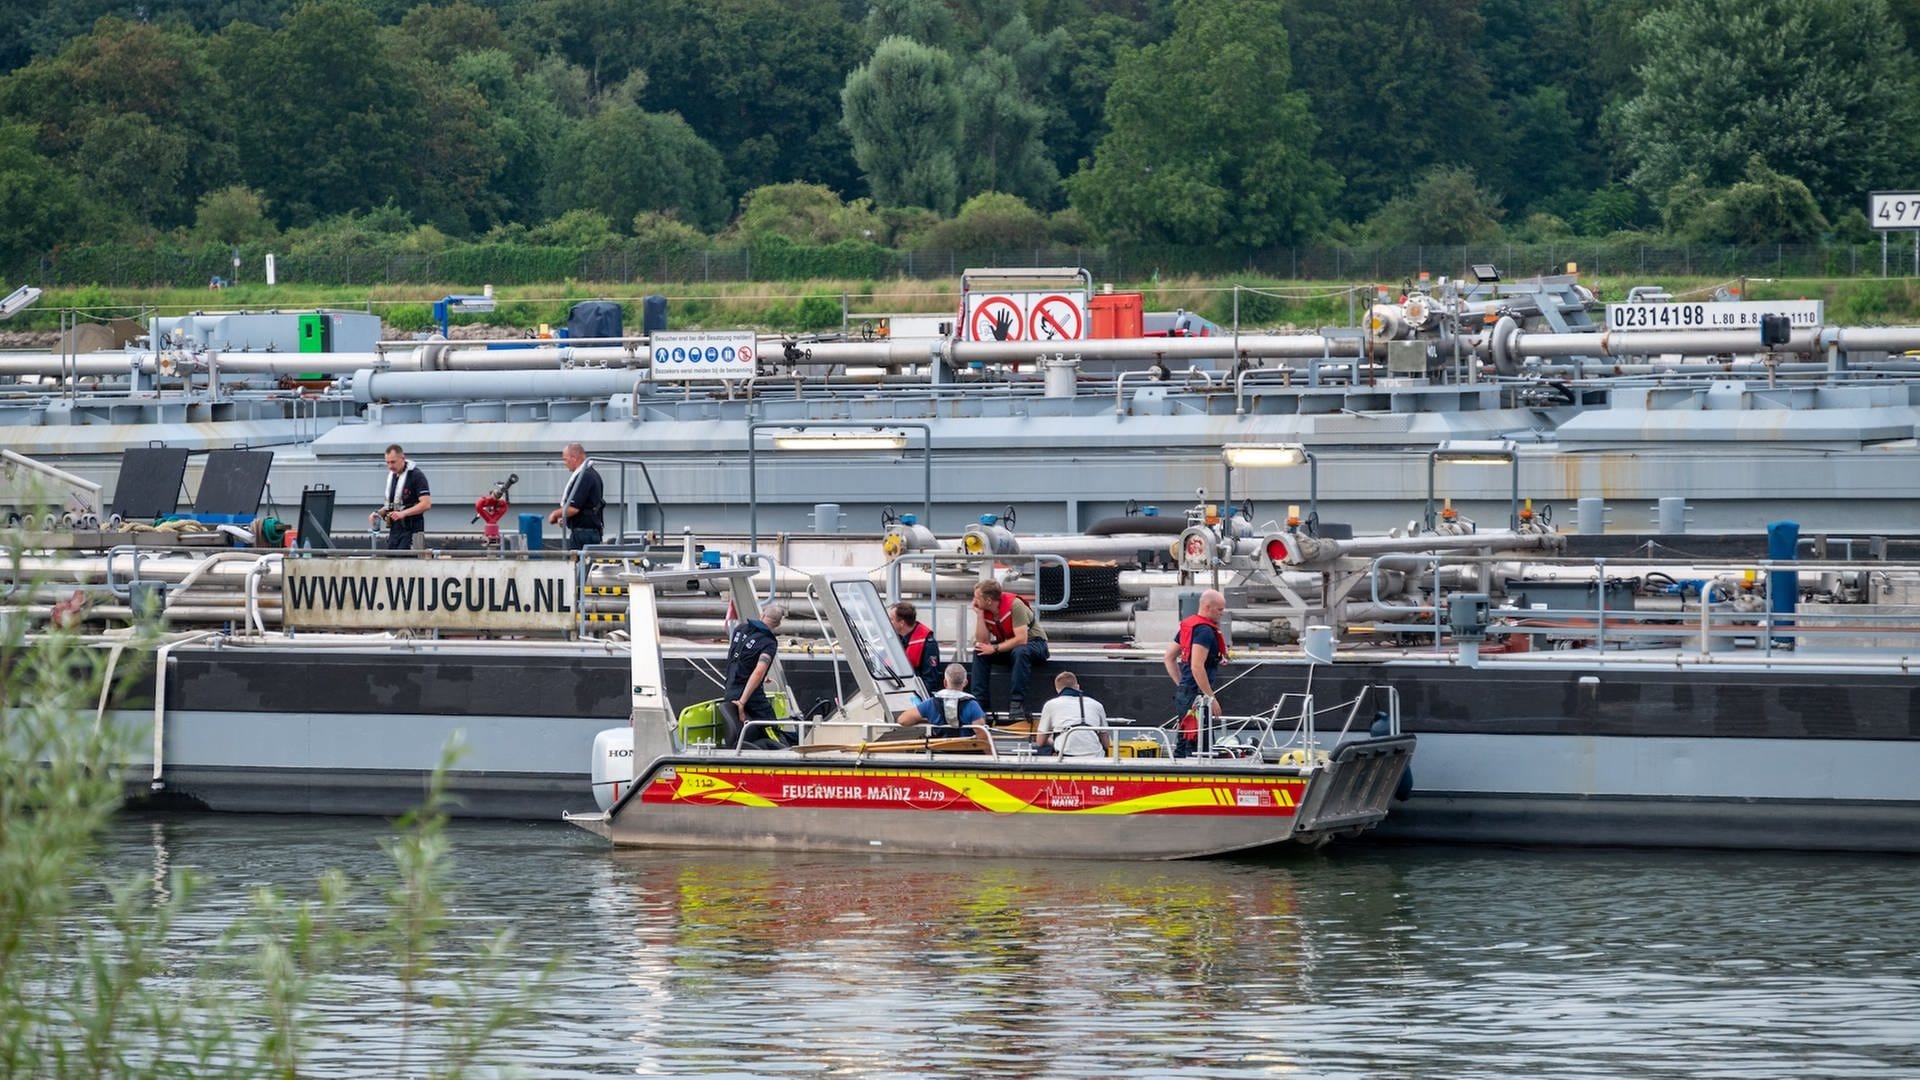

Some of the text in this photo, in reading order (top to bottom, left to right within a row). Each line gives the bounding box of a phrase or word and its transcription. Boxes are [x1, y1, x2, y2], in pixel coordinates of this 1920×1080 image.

[1879, 201, 1920, 220] 497
[1615, 305, 1704, 326] 02314198
[1712, 313, 1735, 325] L.80
[288, 575, 571, 613] WWW.WIJGULA.NL
[695, 779, 714, 787] 112
[782, 785, 945, 801] FEUERWEHR MAINZ 21/79
[1091, 785, 1115, 796] Ralf
[1051, 799, 1080, 807] MAINZ
